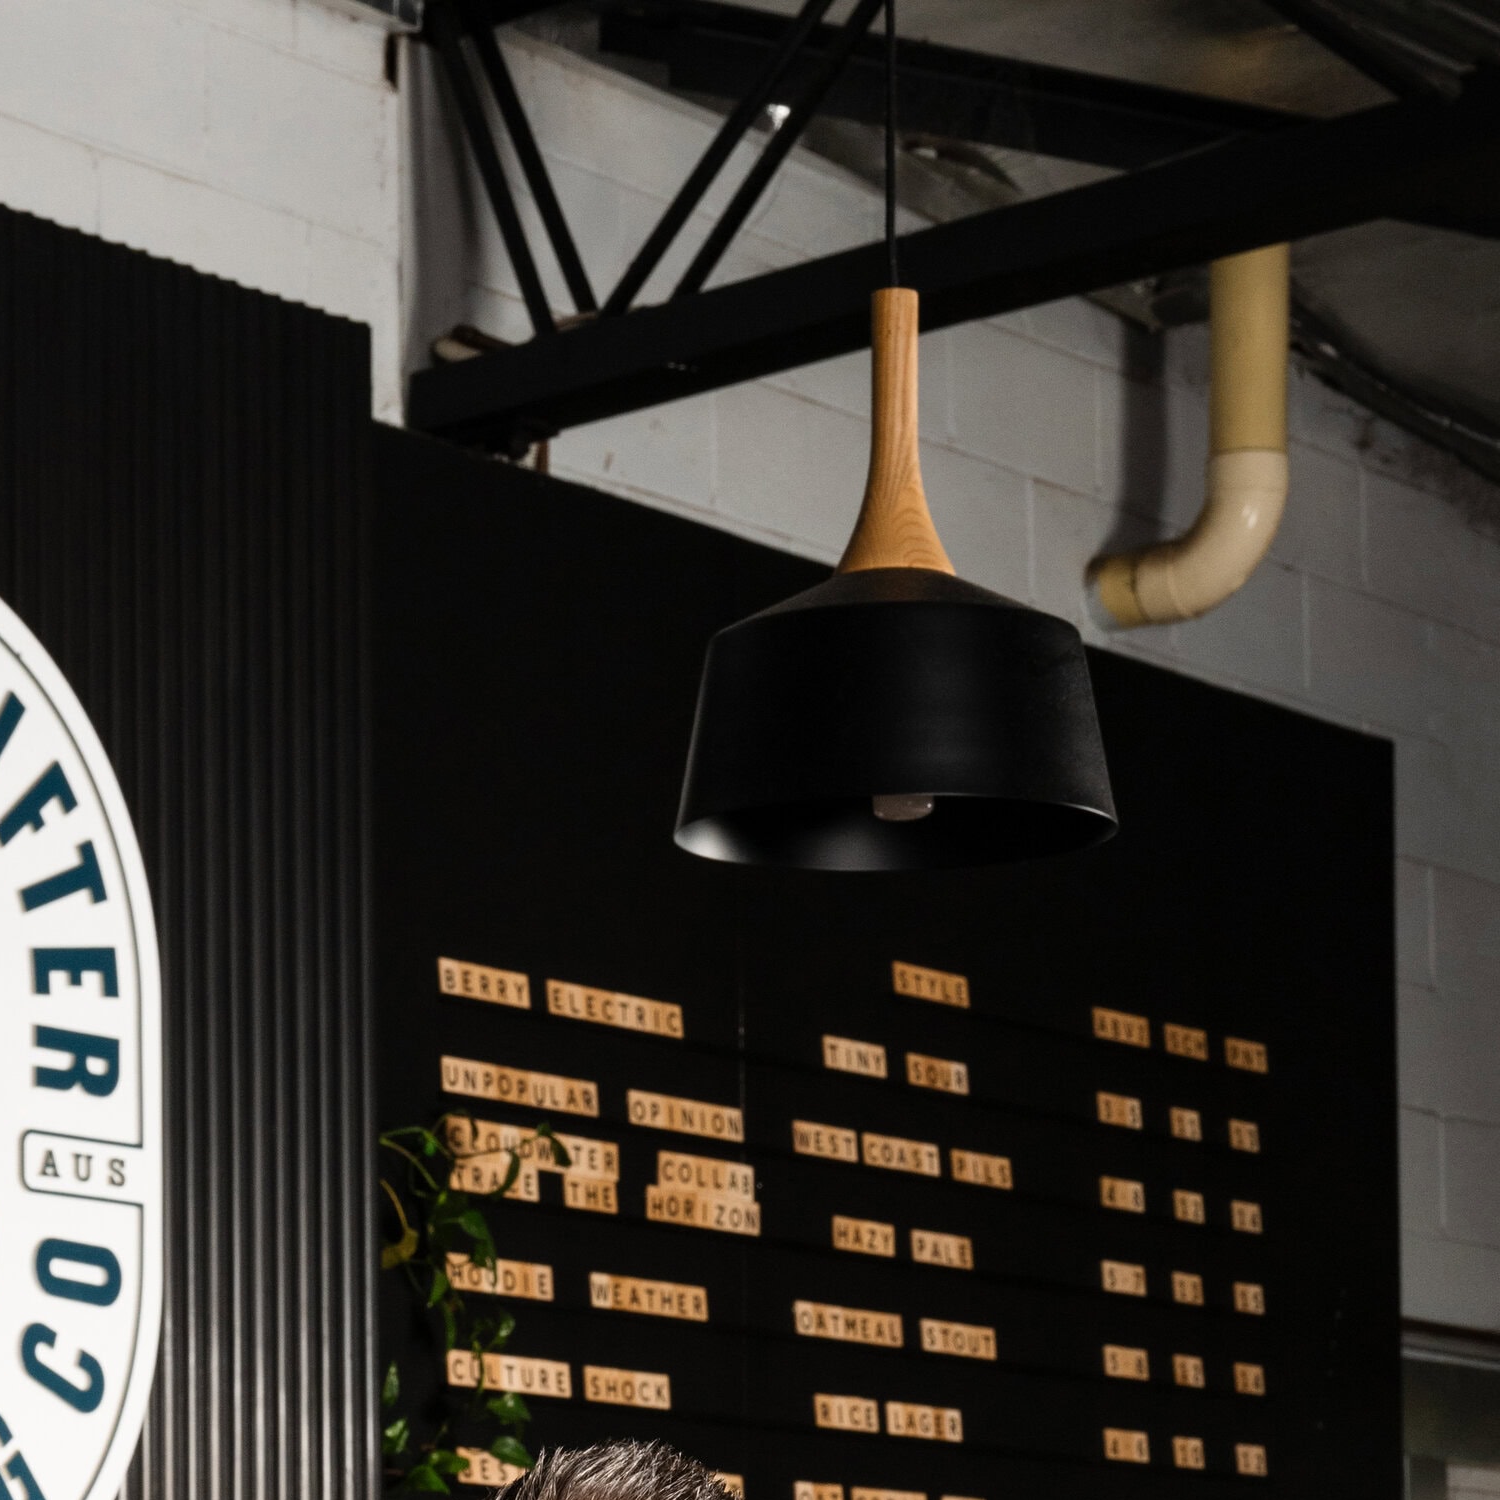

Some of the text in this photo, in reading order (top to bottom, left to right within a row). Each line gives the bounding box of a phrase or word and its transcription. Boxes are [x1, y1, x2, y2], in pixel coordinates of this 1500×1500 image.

[443, 965, 682, 1034] BERRY ELECTRIC
[899, 970, 963, 1002] STYLE
[829, 1043, 962, 1088] TINY SOUR
[445, 1064, 741, 1138] UNPOPULAR OPINION
[40, 1149, 127, 1187] AUS
[662, 1160, 752, 1195] COLLAB
[795, 1128, 1009, 1185] WEST COAST PILS
[455, 1163, 759, 1229] TRAE THE HORIZON
[836, 1223, 967, 1266] HAZY PALE
[592, 1281, 704, 1314] WEATHER
[20, 1237, 123, 1414] CO
[801, 1309, 993, 1354] OATMEAL STOUT
[451, 1358, 667, 1402] CULTURE SHOCK
[821, 1402, 958, 1437] RICE LAGER
